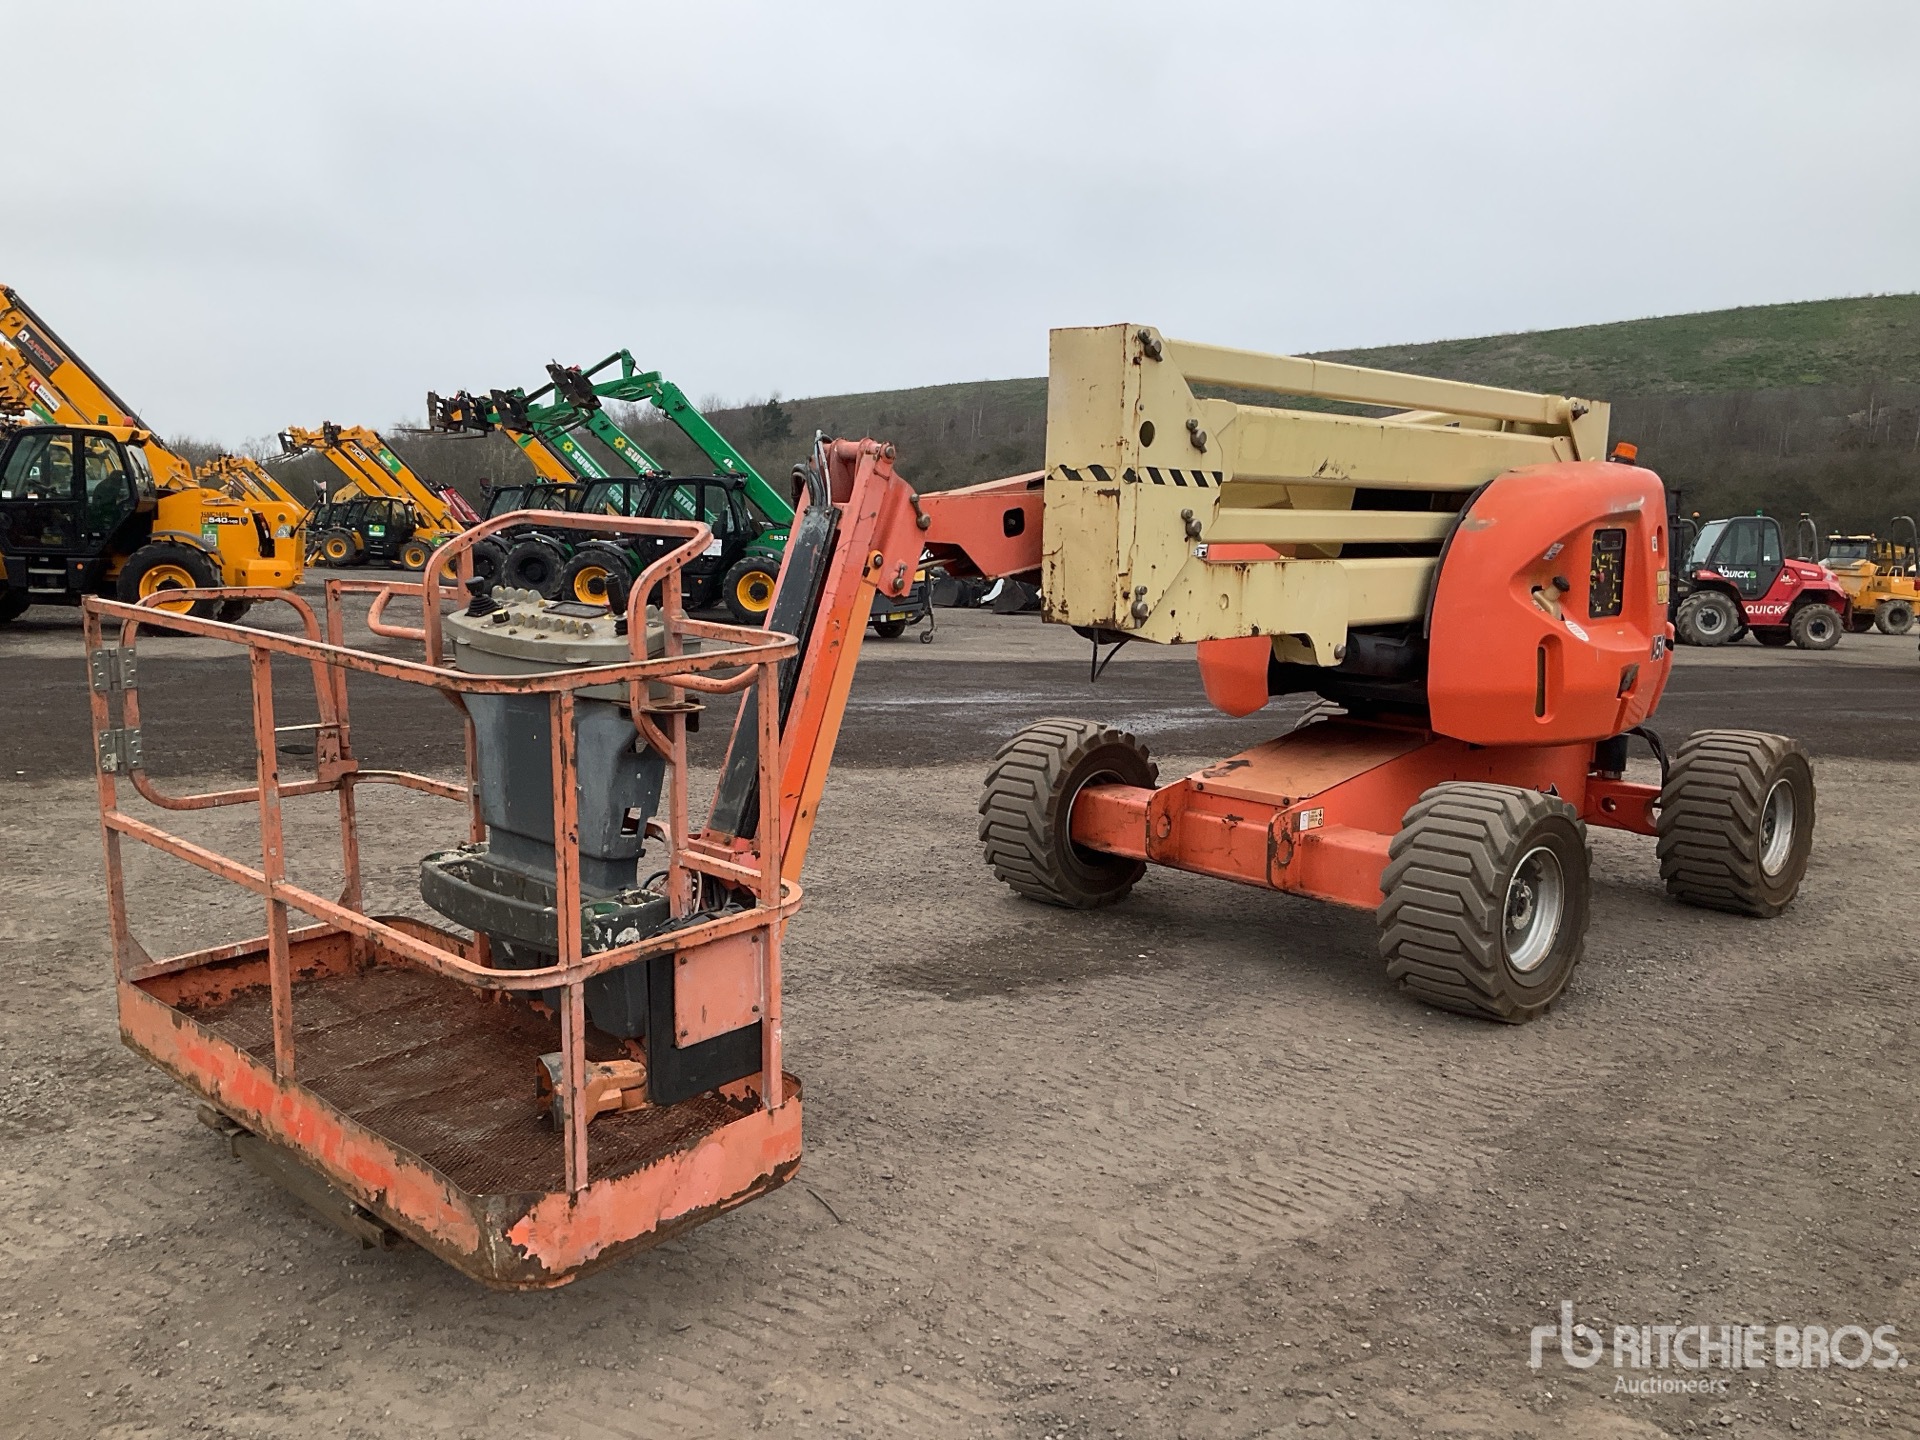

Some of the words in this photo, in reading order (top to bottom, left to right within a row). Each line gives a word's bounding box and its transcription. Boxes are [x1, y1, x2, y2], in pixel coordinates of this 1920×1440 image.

[28, 339, 59, 368] ARDENT
[350, 446, 367, 462] JCB
[1722, 570, 1751, 578] QUICK
[1745, 605, 1782, 614] QUICK
